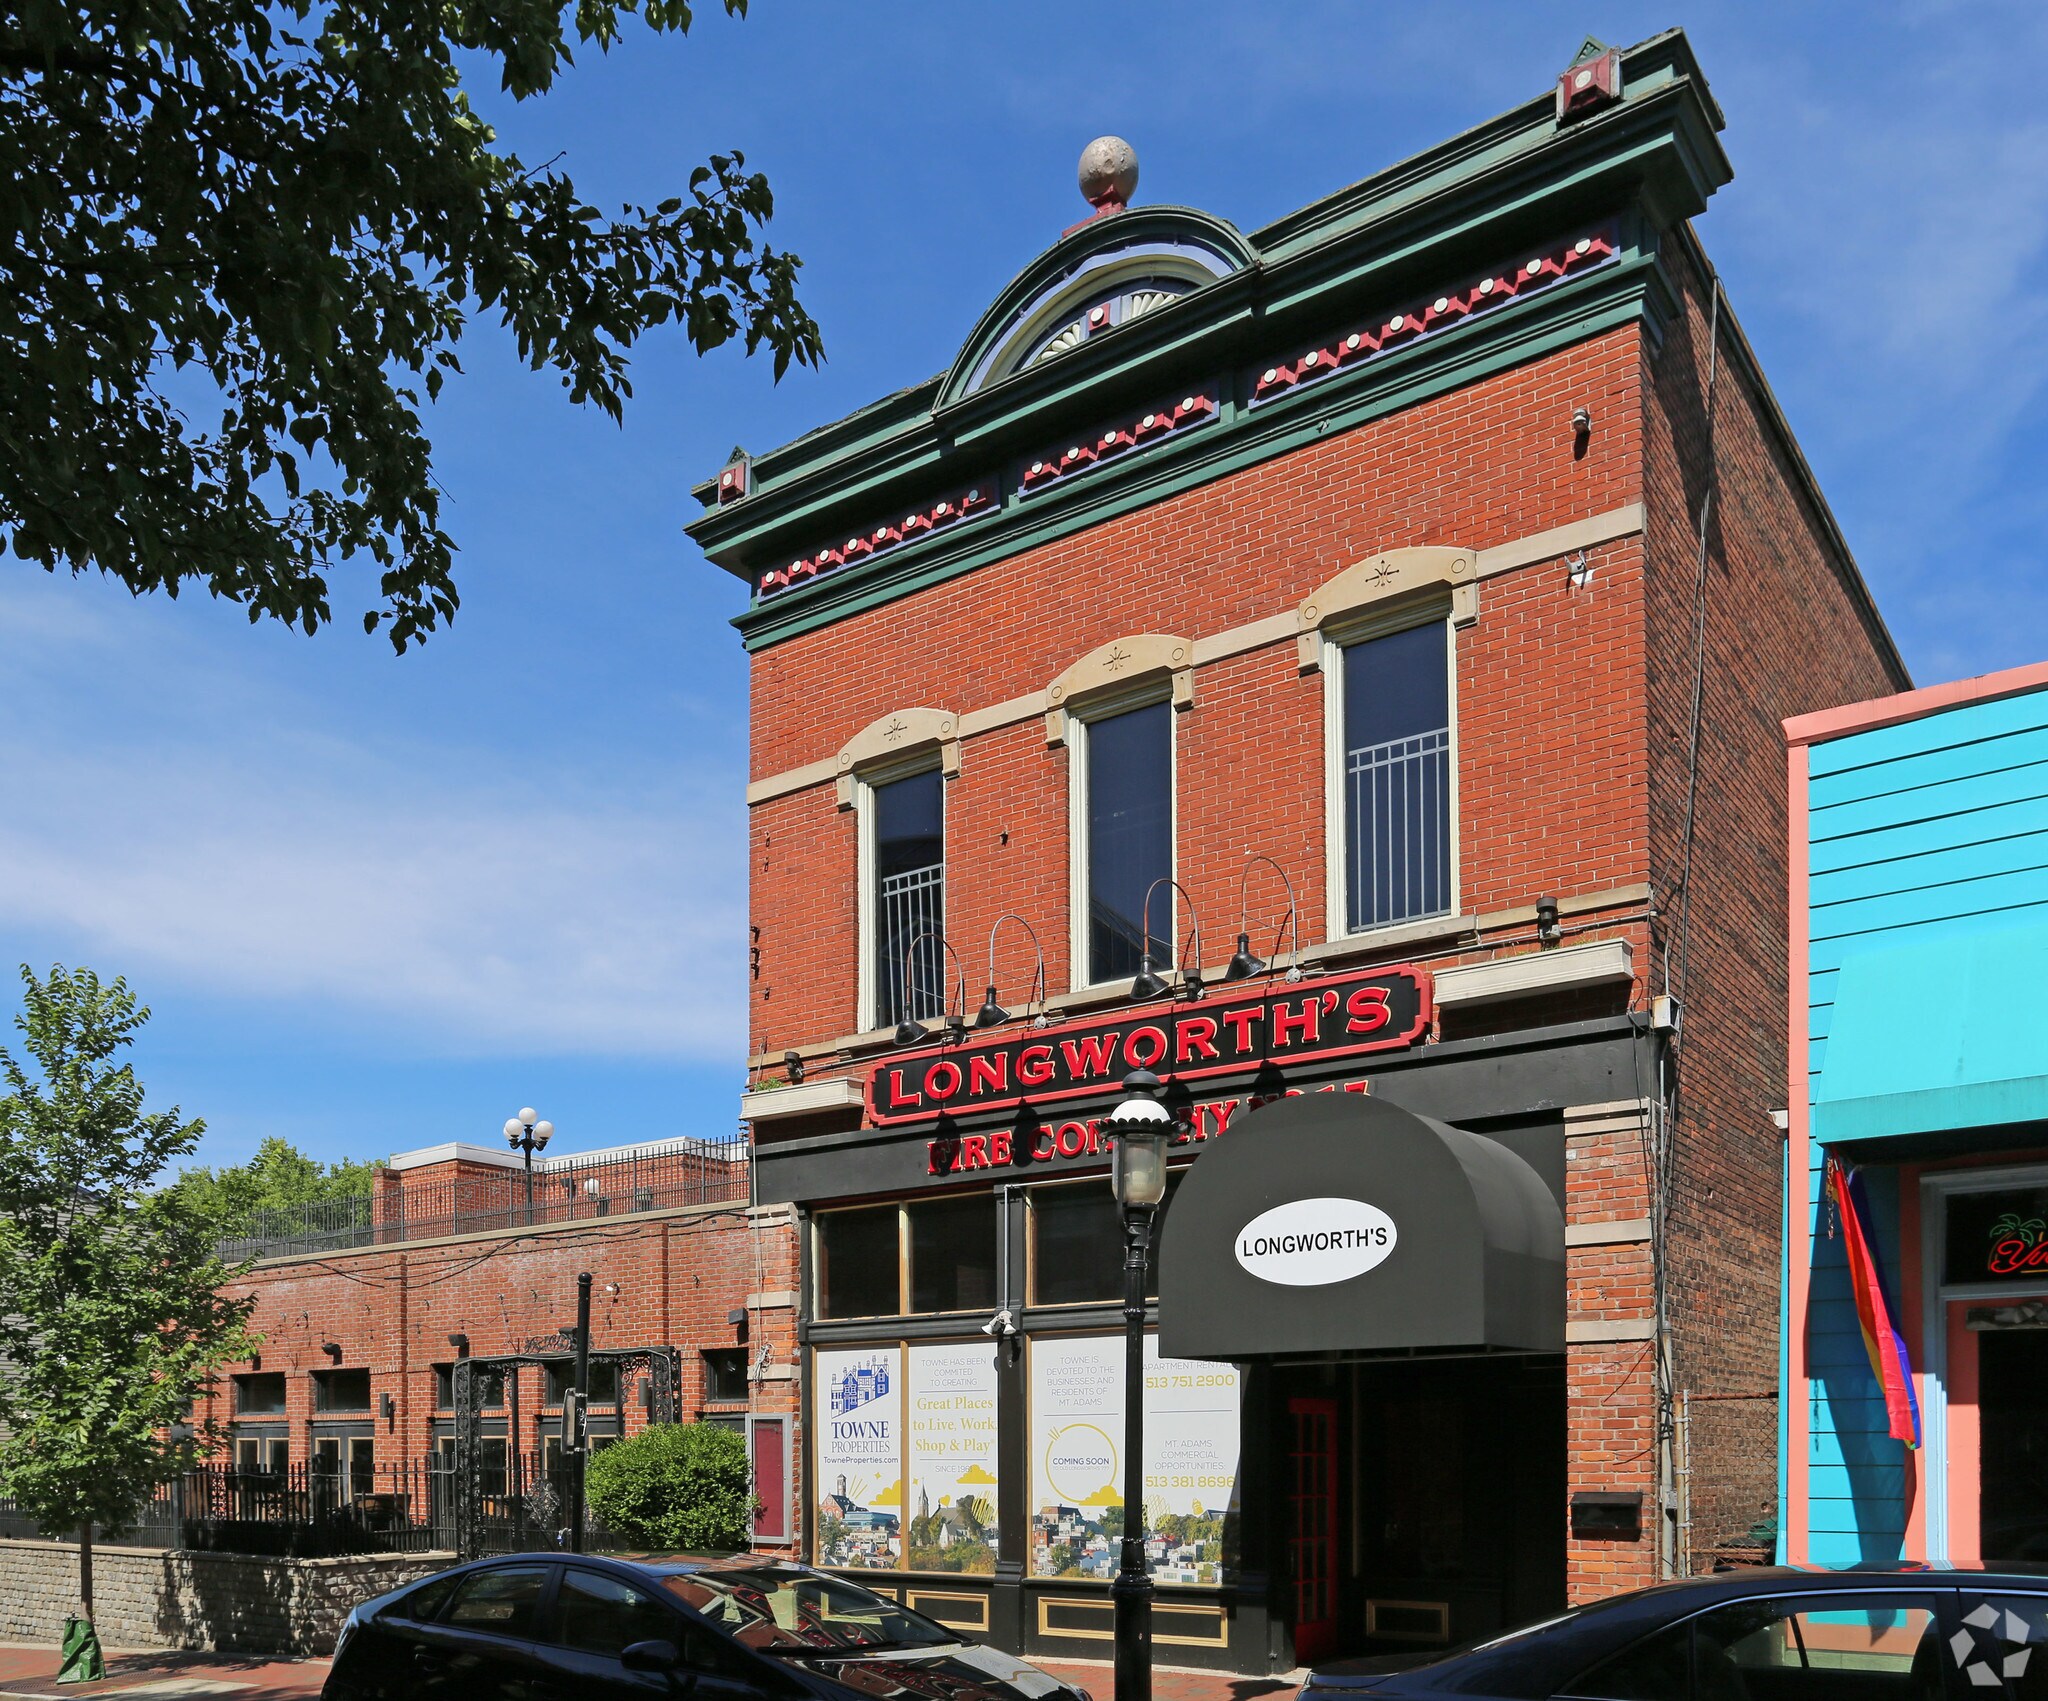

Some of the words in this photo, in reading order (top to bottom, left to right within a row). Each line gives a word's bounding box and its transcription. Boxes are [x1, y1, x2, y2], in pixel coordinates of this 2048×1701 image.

[888, 986, 1393, 1109] LONGWORTH'S
[927, 1130, 1013, 1176] FIRE
[1243, 1227, 1388, 1257] LONGWORTH'S
[921, 1359, 948, 1367] TOWNE
[966, 1358, 987, 1366] BEEN
[1060, 1357, 1090, 1365] TOWNE
[1092, 1356, 1099, 1364] IS
[933, 1368, 973, 1377] COMMITED
[1046, 1367, 1084, 1376] DEVOTED
[1086, 1367, 1098, 1375] TO
[1100, 1366, 1115, 1374] THE
[930, 1379, 941, 1387] TO
[941, 1378, 978, 1387] CREATING
[1047, 1378, 1096, 1386] BUSINESSES
[1097, 1377, 1115, 1385] AND
[1146, 1377, 1168, 1388] 513
[1171, 1376, 1193, 1388] 751
[1196, 1374, 1235, 1387] 2900
[1051, 1388, 1095, 1396] RESIDENTS
[1096, 1388, 1108, 1396] OF
[917, 1397, 951, 1410] Great
[954, 1396, 994, 1410] Places
[1073, 1398, 1103, 1406] ADAMS
[913, 1420, 925, 1431] to
[928, 1418, 957, 1432] Live,
[831, 1421, 889, 1439] TOWNE
[831, 1440, 890, 1453] PROPERTIES
[915, 1439, 946, 1455] Shop
[949, 1438, 960, 1451] &
[1161, 1451, 1219, 1459] COMMERCIAL
[823, 1456, 899, 1465] TowneProperties.com
[1052, 1457, 1084, 1465] COMING
[1085, 1457, 1110, 1465] SOON
[935, 1465, 956, 1473] SINCE
[1145, 1476, 1168, 1488] 513
[1171, 1476, 1195, 1488] 381
[1197, 1476, 1236, 1488] 8696
